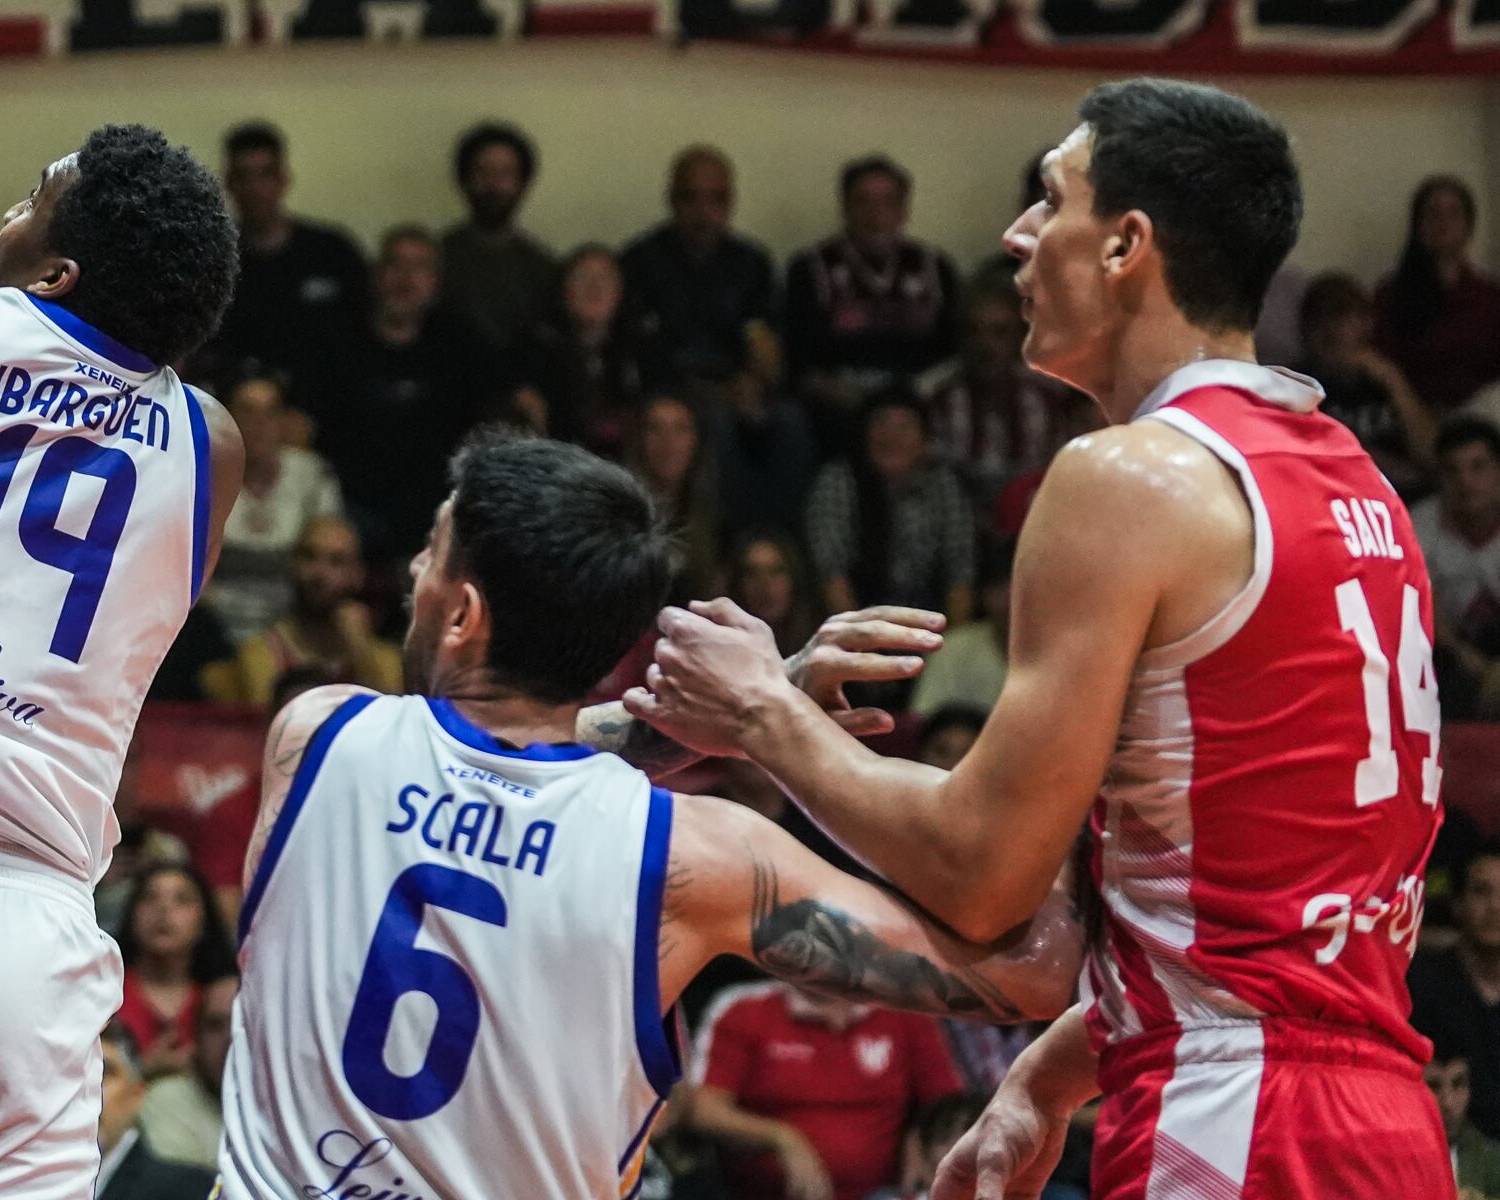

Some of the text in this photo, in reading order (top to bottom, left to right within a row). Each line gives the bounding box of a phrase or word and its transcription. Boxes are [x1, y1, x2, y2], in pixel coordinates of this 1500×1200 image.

[73, 361, 140, 397] XENEI
[1330, 497, 1405, 560] SAIZ
[1334, 577, 1444, 812] 14
[444, 763, 539, 800] XENEIZE
[385, 783, 558, 877] SCALA
[342, 861, 508, 1122] 6
